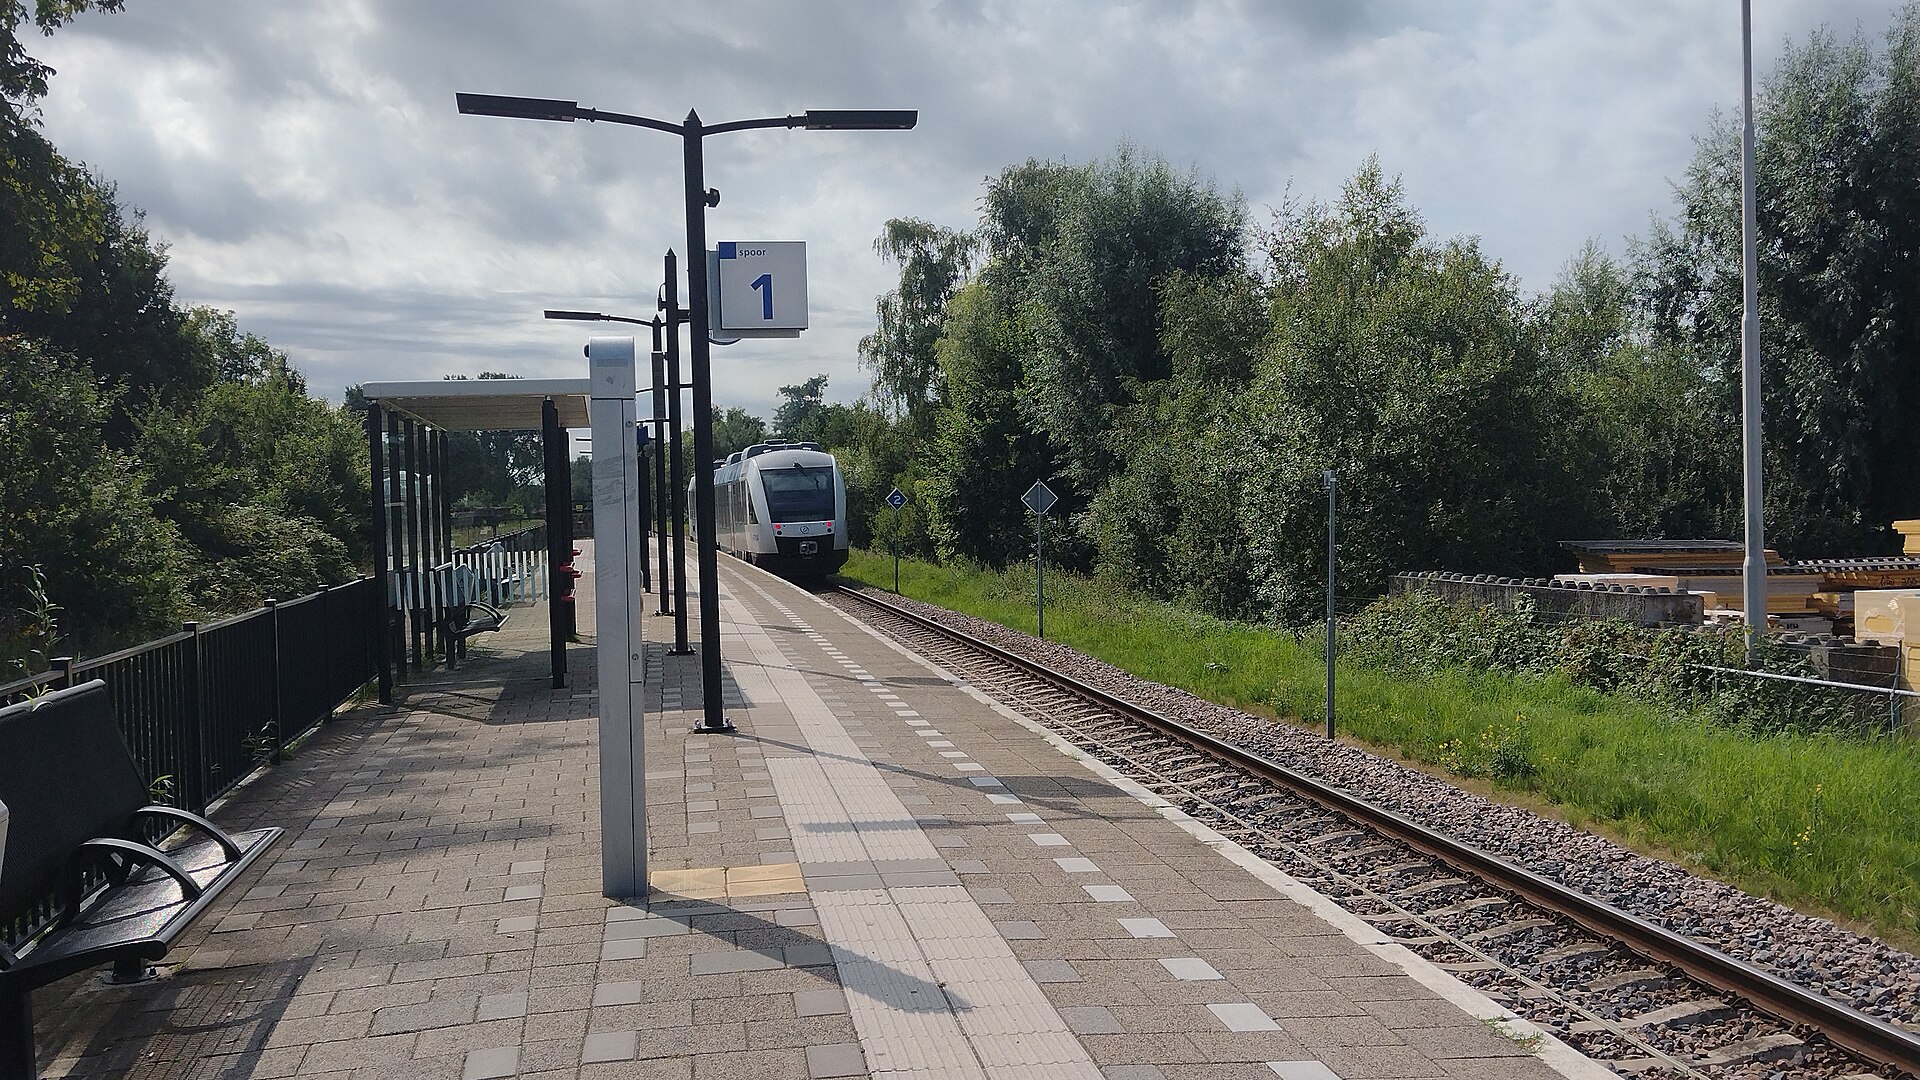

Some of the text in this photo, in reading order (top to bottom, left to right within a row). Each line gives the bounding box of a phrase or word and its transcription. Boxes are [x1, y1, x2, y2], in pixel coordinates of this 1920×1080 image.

[739, 248, 767, 258] spoor
[750, 273, 774, 320] 1
[893, 494, 902, 505] 2
